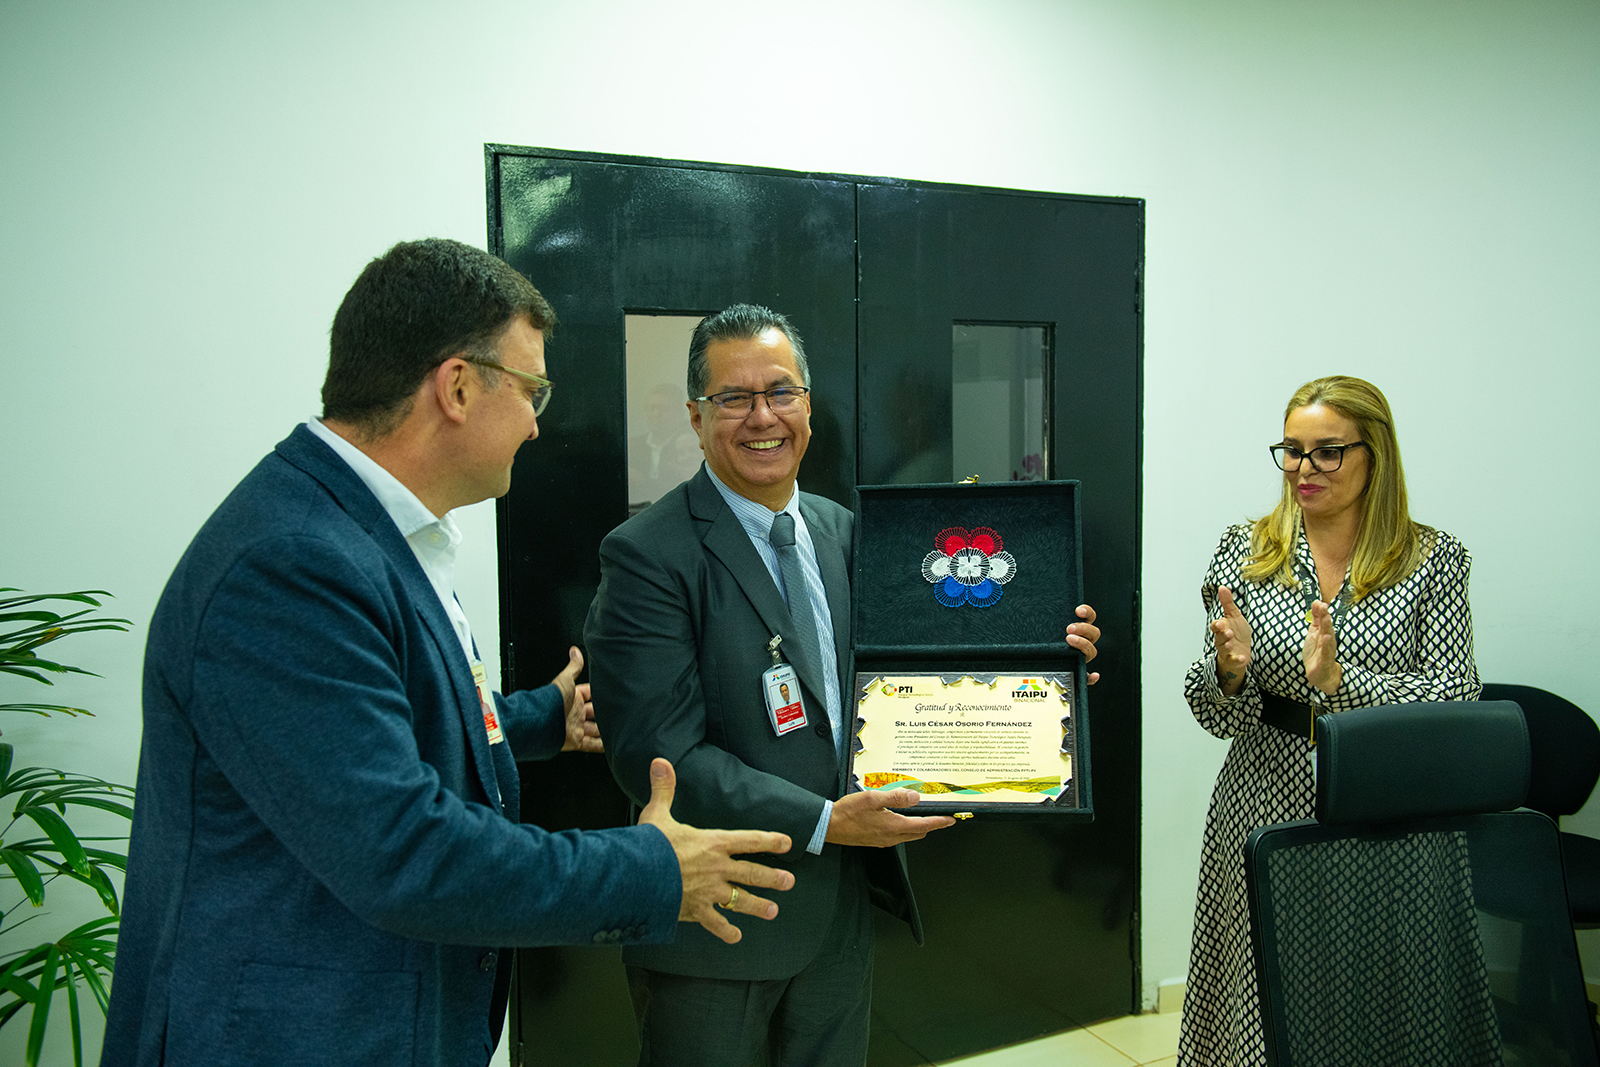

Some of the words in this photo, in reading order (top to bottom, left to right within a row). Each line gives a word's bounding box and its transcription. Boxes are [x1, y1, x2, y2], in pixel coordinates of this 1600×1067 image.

[914, 703, 948, 714] Gratitud
[948, 705, 955, 714] y
[955, 703, 1012, 712] Reconocimiento
